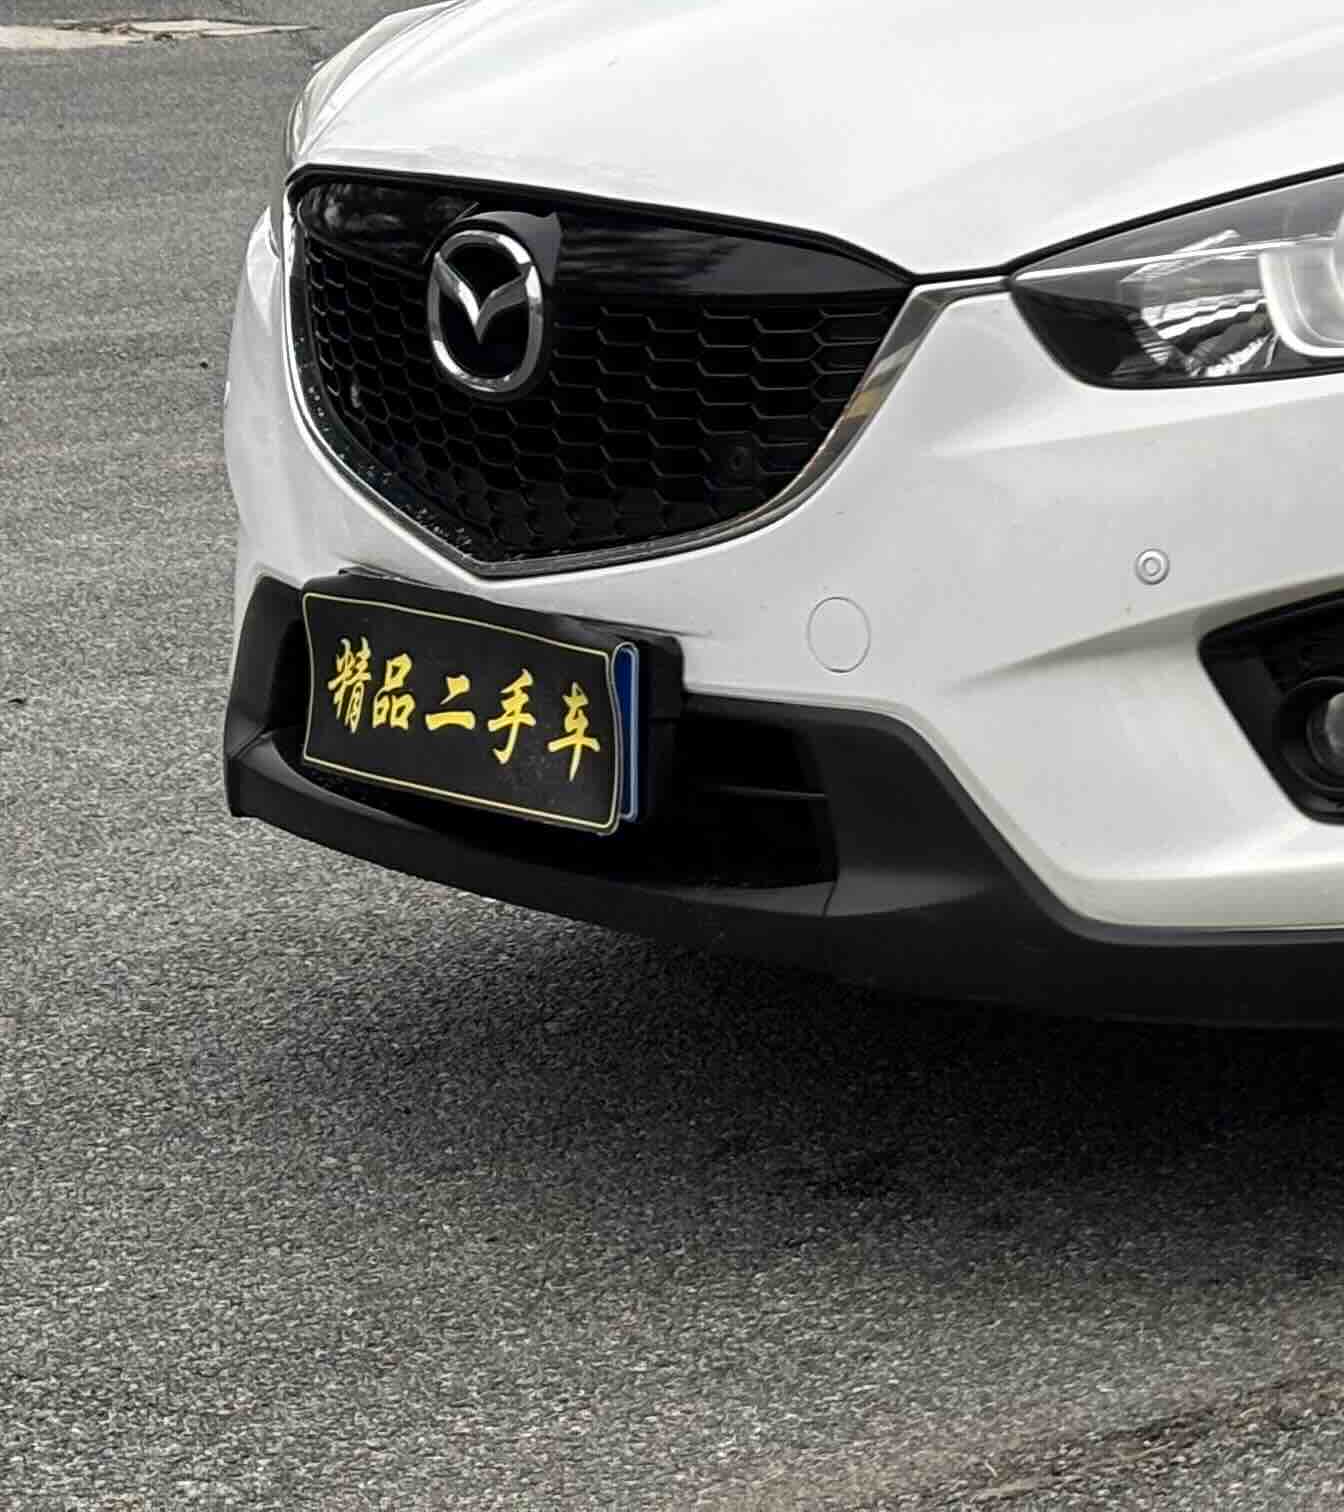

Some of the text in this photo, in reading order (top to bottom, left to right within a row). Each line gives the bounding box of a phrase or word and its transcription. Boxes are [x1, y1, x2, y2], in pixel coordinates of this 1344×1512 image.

[327, 637, 601, 783] 精品二手车
